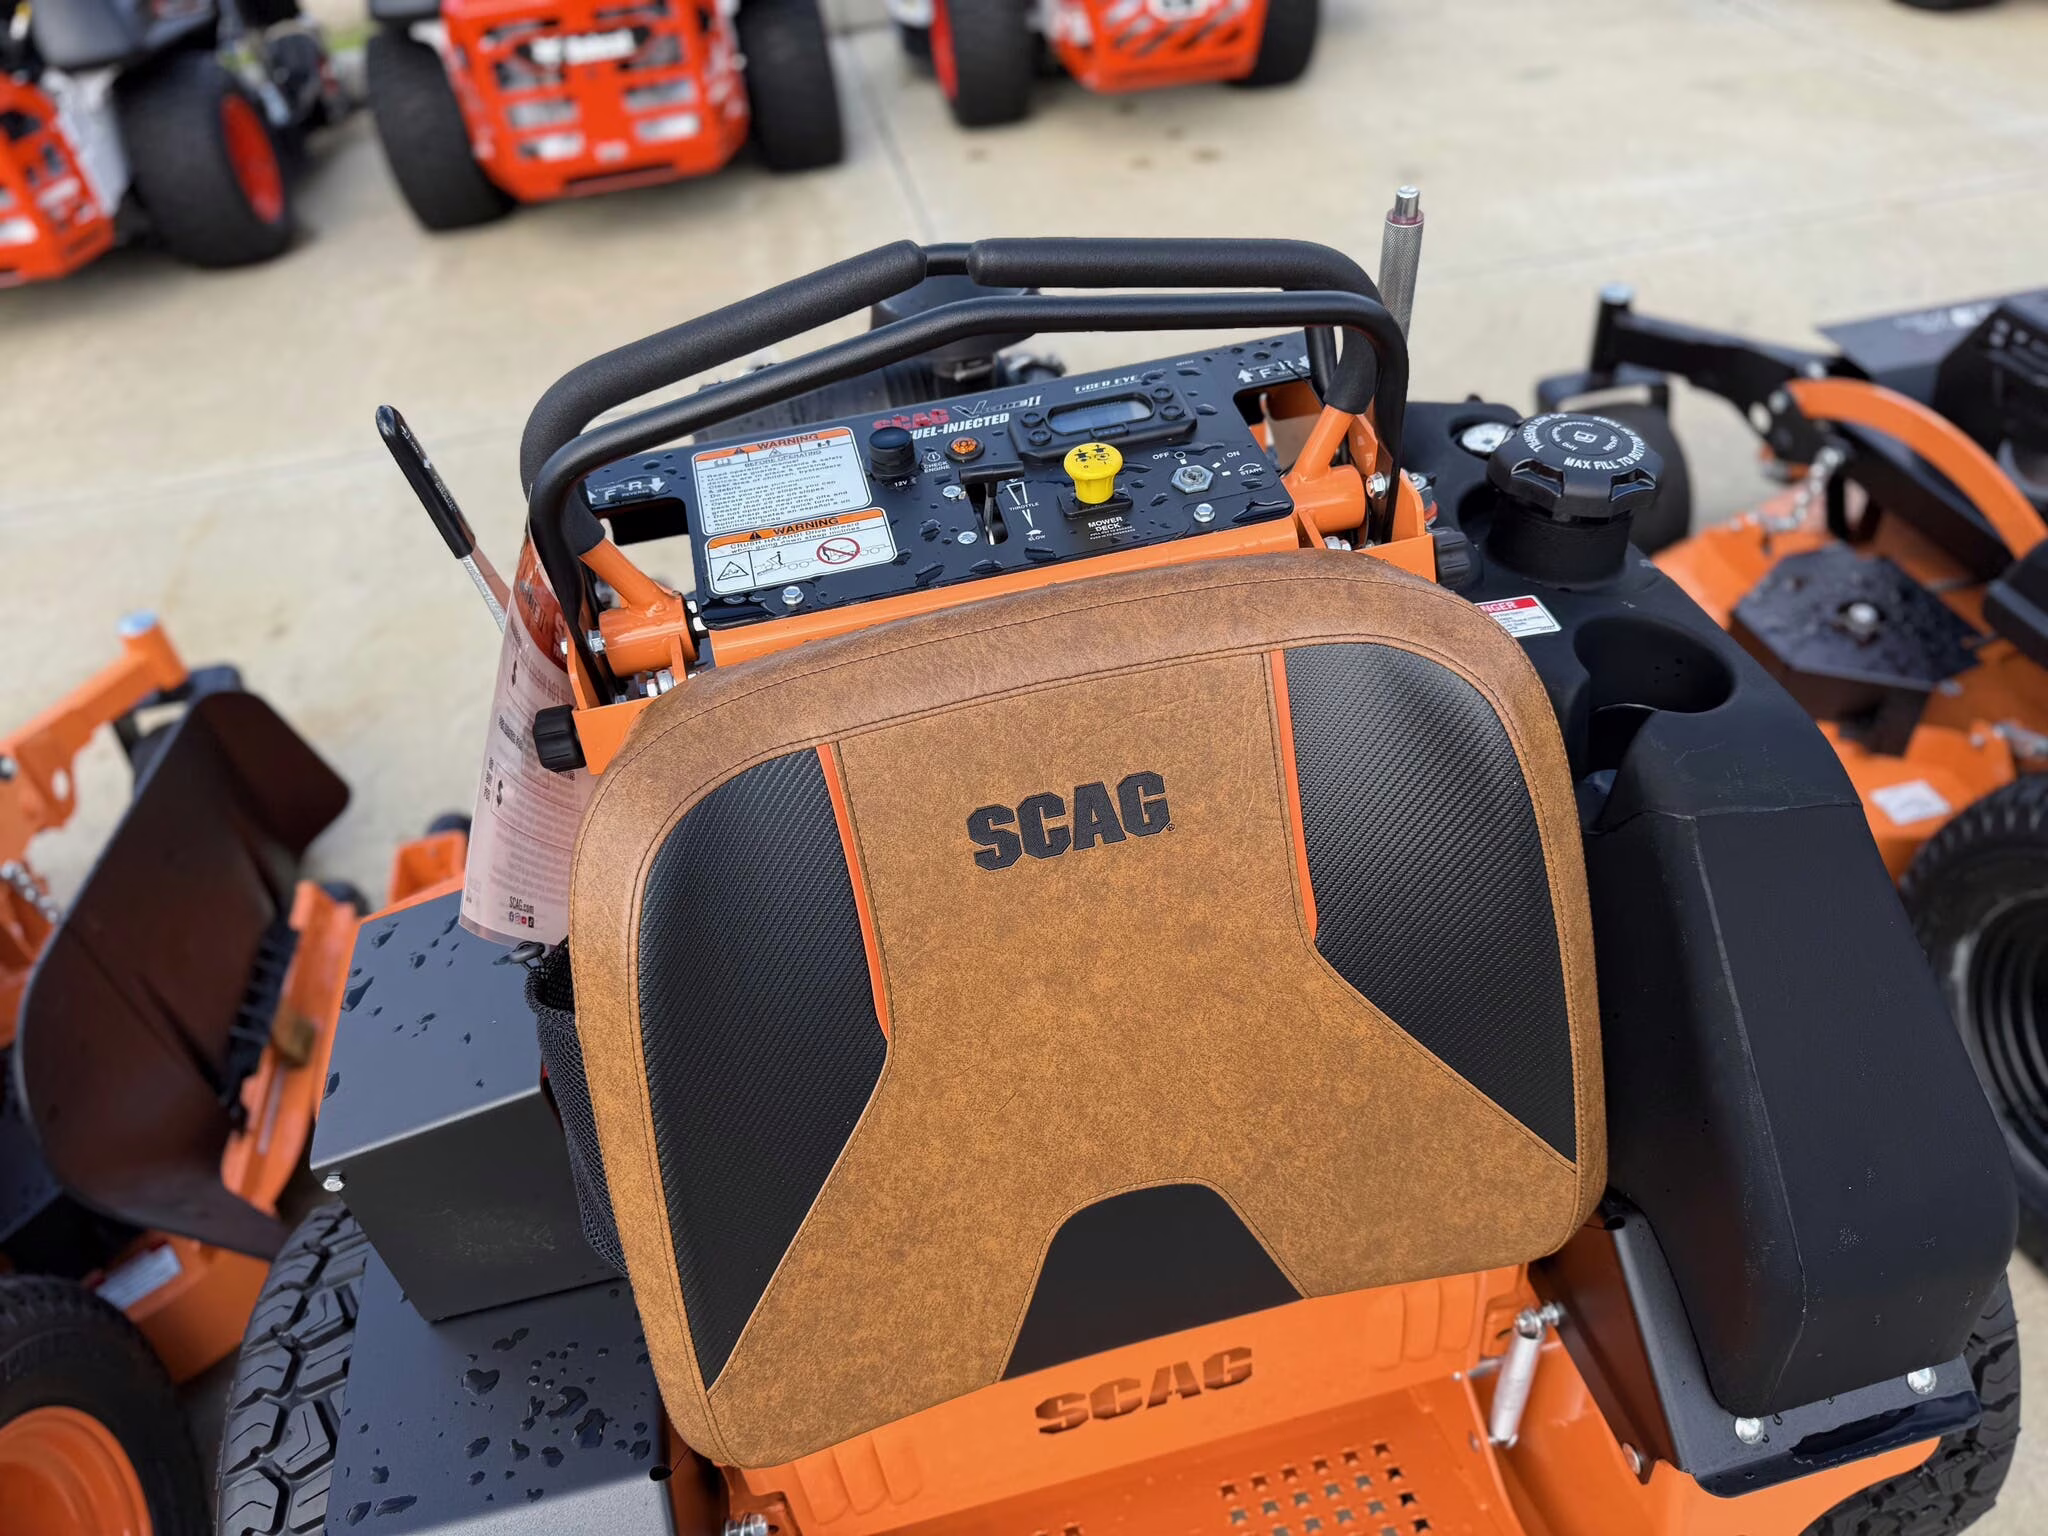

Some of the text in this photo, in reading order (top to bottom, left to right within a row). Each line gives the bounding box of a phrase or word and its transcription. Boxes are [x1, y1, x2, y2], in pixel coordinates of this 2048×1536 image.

[756, 433, 819, 450] WARNING
[1152, 452, 1170, 460] OFF
[1226, 450, 1241, 458] ON
[923, 461, 948, 469] CHECK
[1563, 456, 1592, 470] MAX
[1593, 460, 1620, 470] FILL
[1616, 455, 1634, 467] TO
[923, 465, 951, 473] ENGINE
[628, 481, 642, 491] R
[1009, 502, 1039, 511] THROTTLE
[773, 517, 839, 536] WARNING
[829, 521, 859, 531] forward
[1088, 516, 1122, 528] MOWER
[1095, 522, 1120, 532] DECK
[1028, 534, 1046, 542] SLOW
[1480, 601, 1517, 613] NGER
[966, 770, 1170, 871] SCAG
[509, 896, 535, 914] SCAG.com
[1035, 1346, 1252, 1435] SCAG
